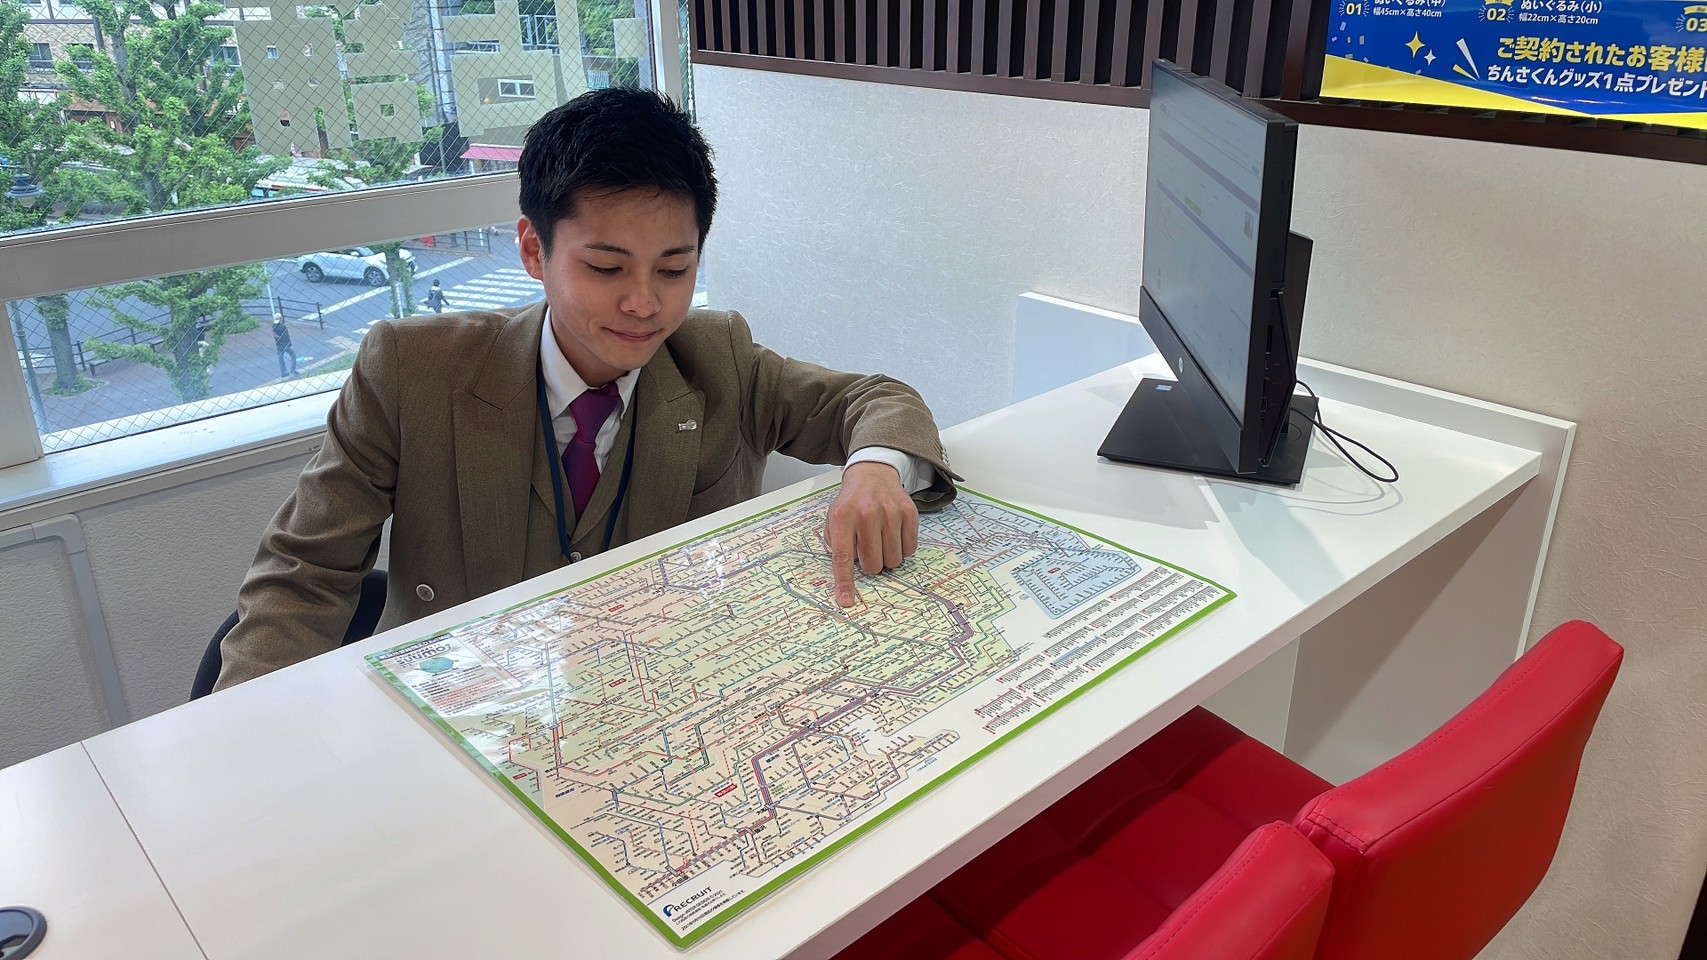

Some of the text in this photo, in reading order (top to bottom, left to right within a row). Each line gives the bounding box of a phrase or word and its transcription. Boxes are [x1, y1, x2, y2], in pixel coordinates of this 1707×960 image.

[1346, 3, 1362, 15] 01
[1487, 8, 1507, 21] 02
[1686, 18, 1707, 32] 03
[1497, 35, 1707, 73] ご契約されたお客様
[674, 886, 712, 912] RECRUIT
